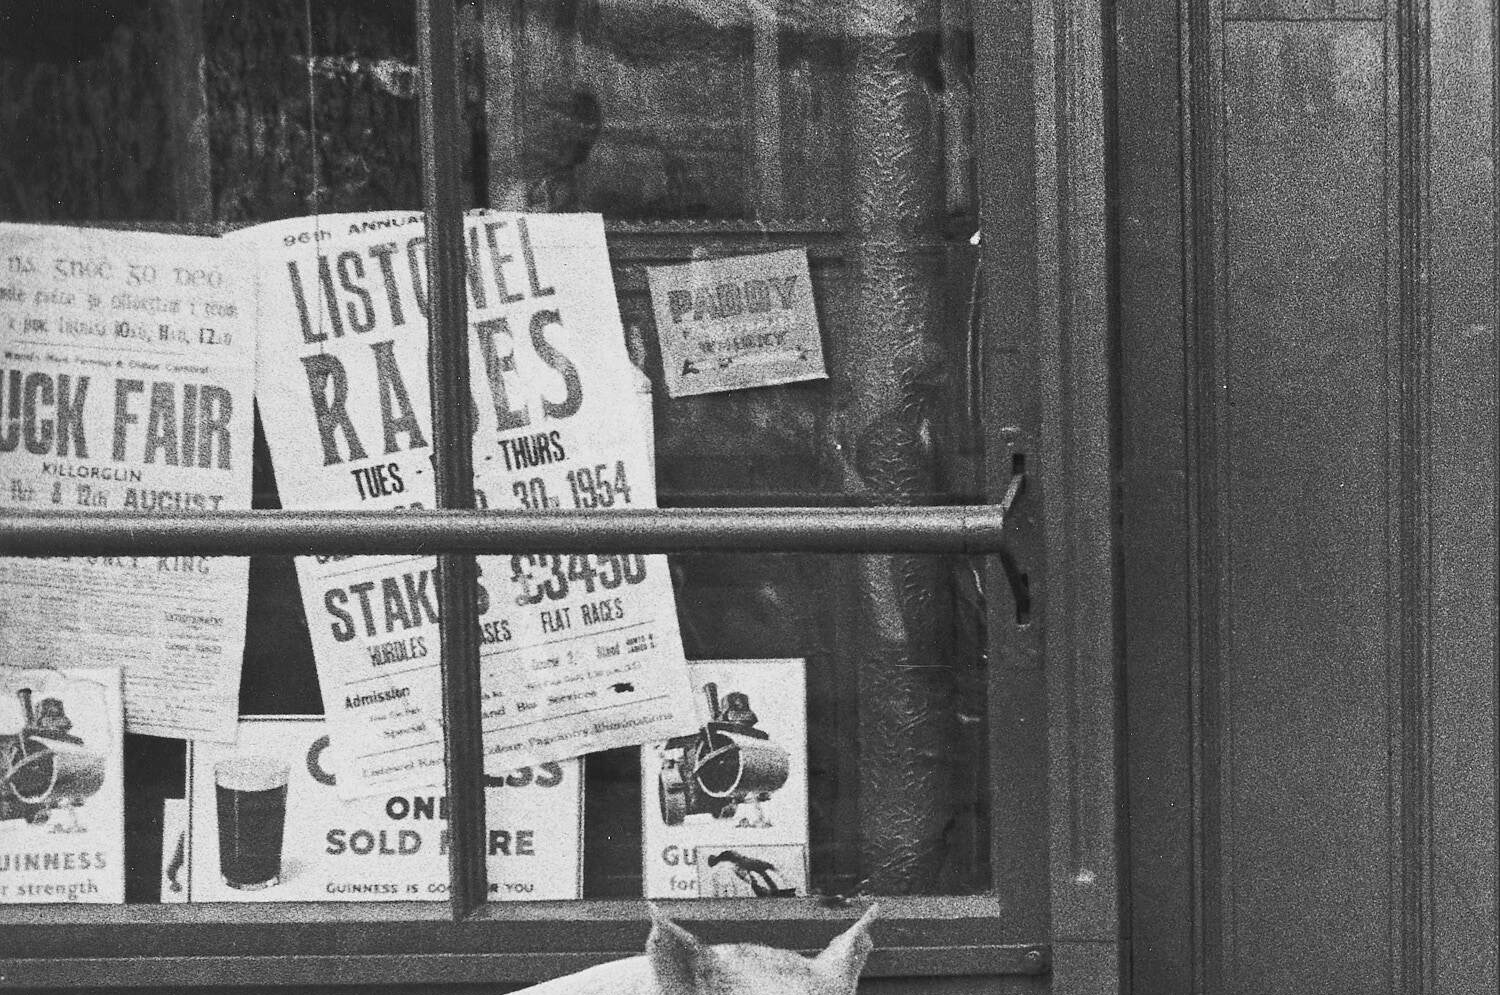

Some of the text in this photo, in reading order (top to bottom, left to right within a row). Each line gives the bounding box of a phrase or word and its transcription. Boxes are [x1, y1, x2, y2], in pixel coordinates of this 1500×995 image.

[282, 230, 332, 247] 96th
[300, 309, 584, 467] RAES
[112, 378, 234, 470] FAIR
[42, 461, 142, 483] KILLORGLIN
[566, 460, 631, 509] 1954
[124, 487, 224, 510] AUGUST
[366, 636, 428, 669] HURDLES
[541, 607, 571, 634] FLAT
[581, 598, 624, 626] RACES
[344, 687, 411, 710] Admission
[325, 829, 423, 856] SOLD
[17, 879, 98, 902] strength
[326, 882, 398, 894] GUINNESS
[406, 883, 418, 894] IS
[504, 882, 535, 894] YOU
[668, 875, 697, 892] for
